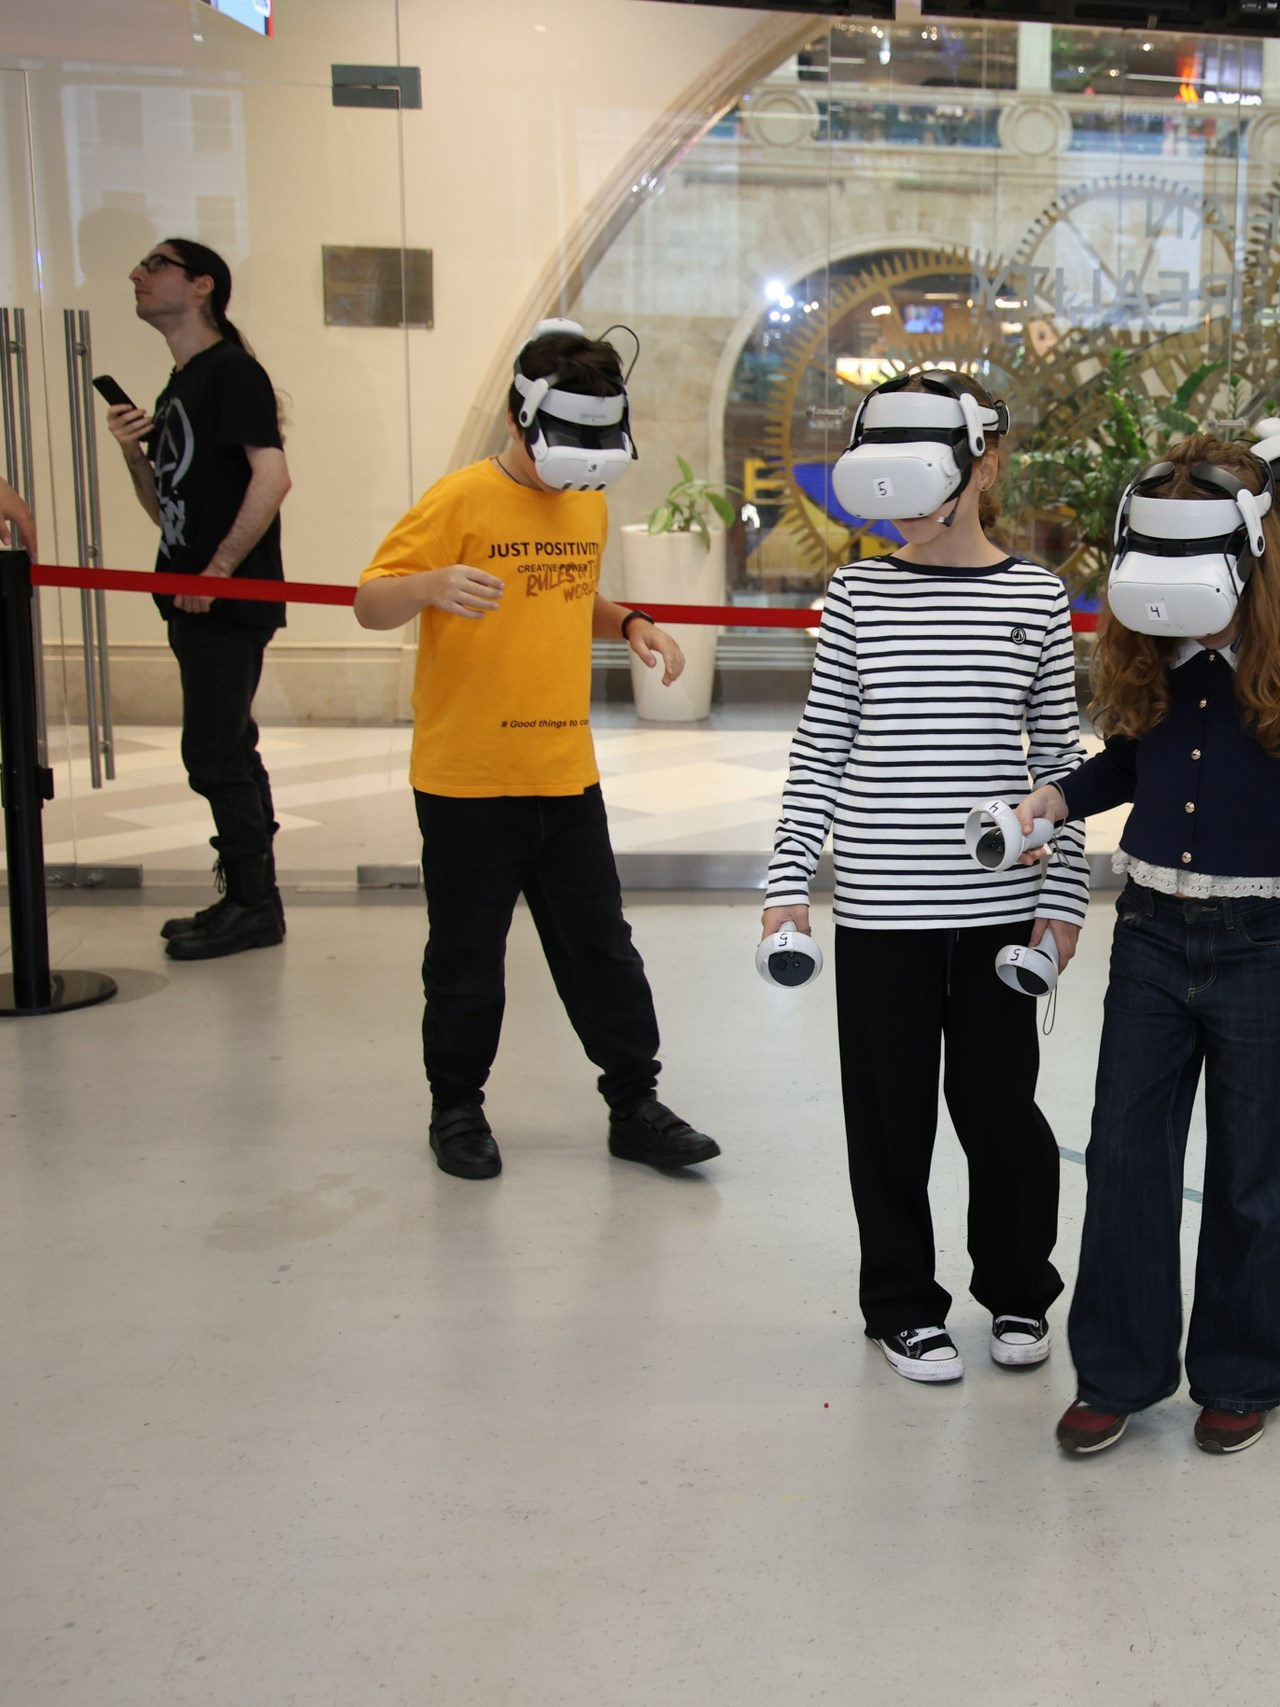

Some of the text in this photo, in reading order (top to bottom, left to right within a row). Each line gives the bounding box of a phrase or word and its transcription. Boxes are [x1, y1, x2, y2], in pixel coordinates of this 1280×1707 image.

[877, 480, 888, 496] 5
[488, 542, 530, 558] JUST
[517, 563, 558, 574] CREATIVE
[525, 562, 575, 598] RULES
[1150, 605, 1161, 618] 4
[510, 719, 536, 729] Good
[539, 719, 567, 729] things
[569, 719, 578, 727] to
